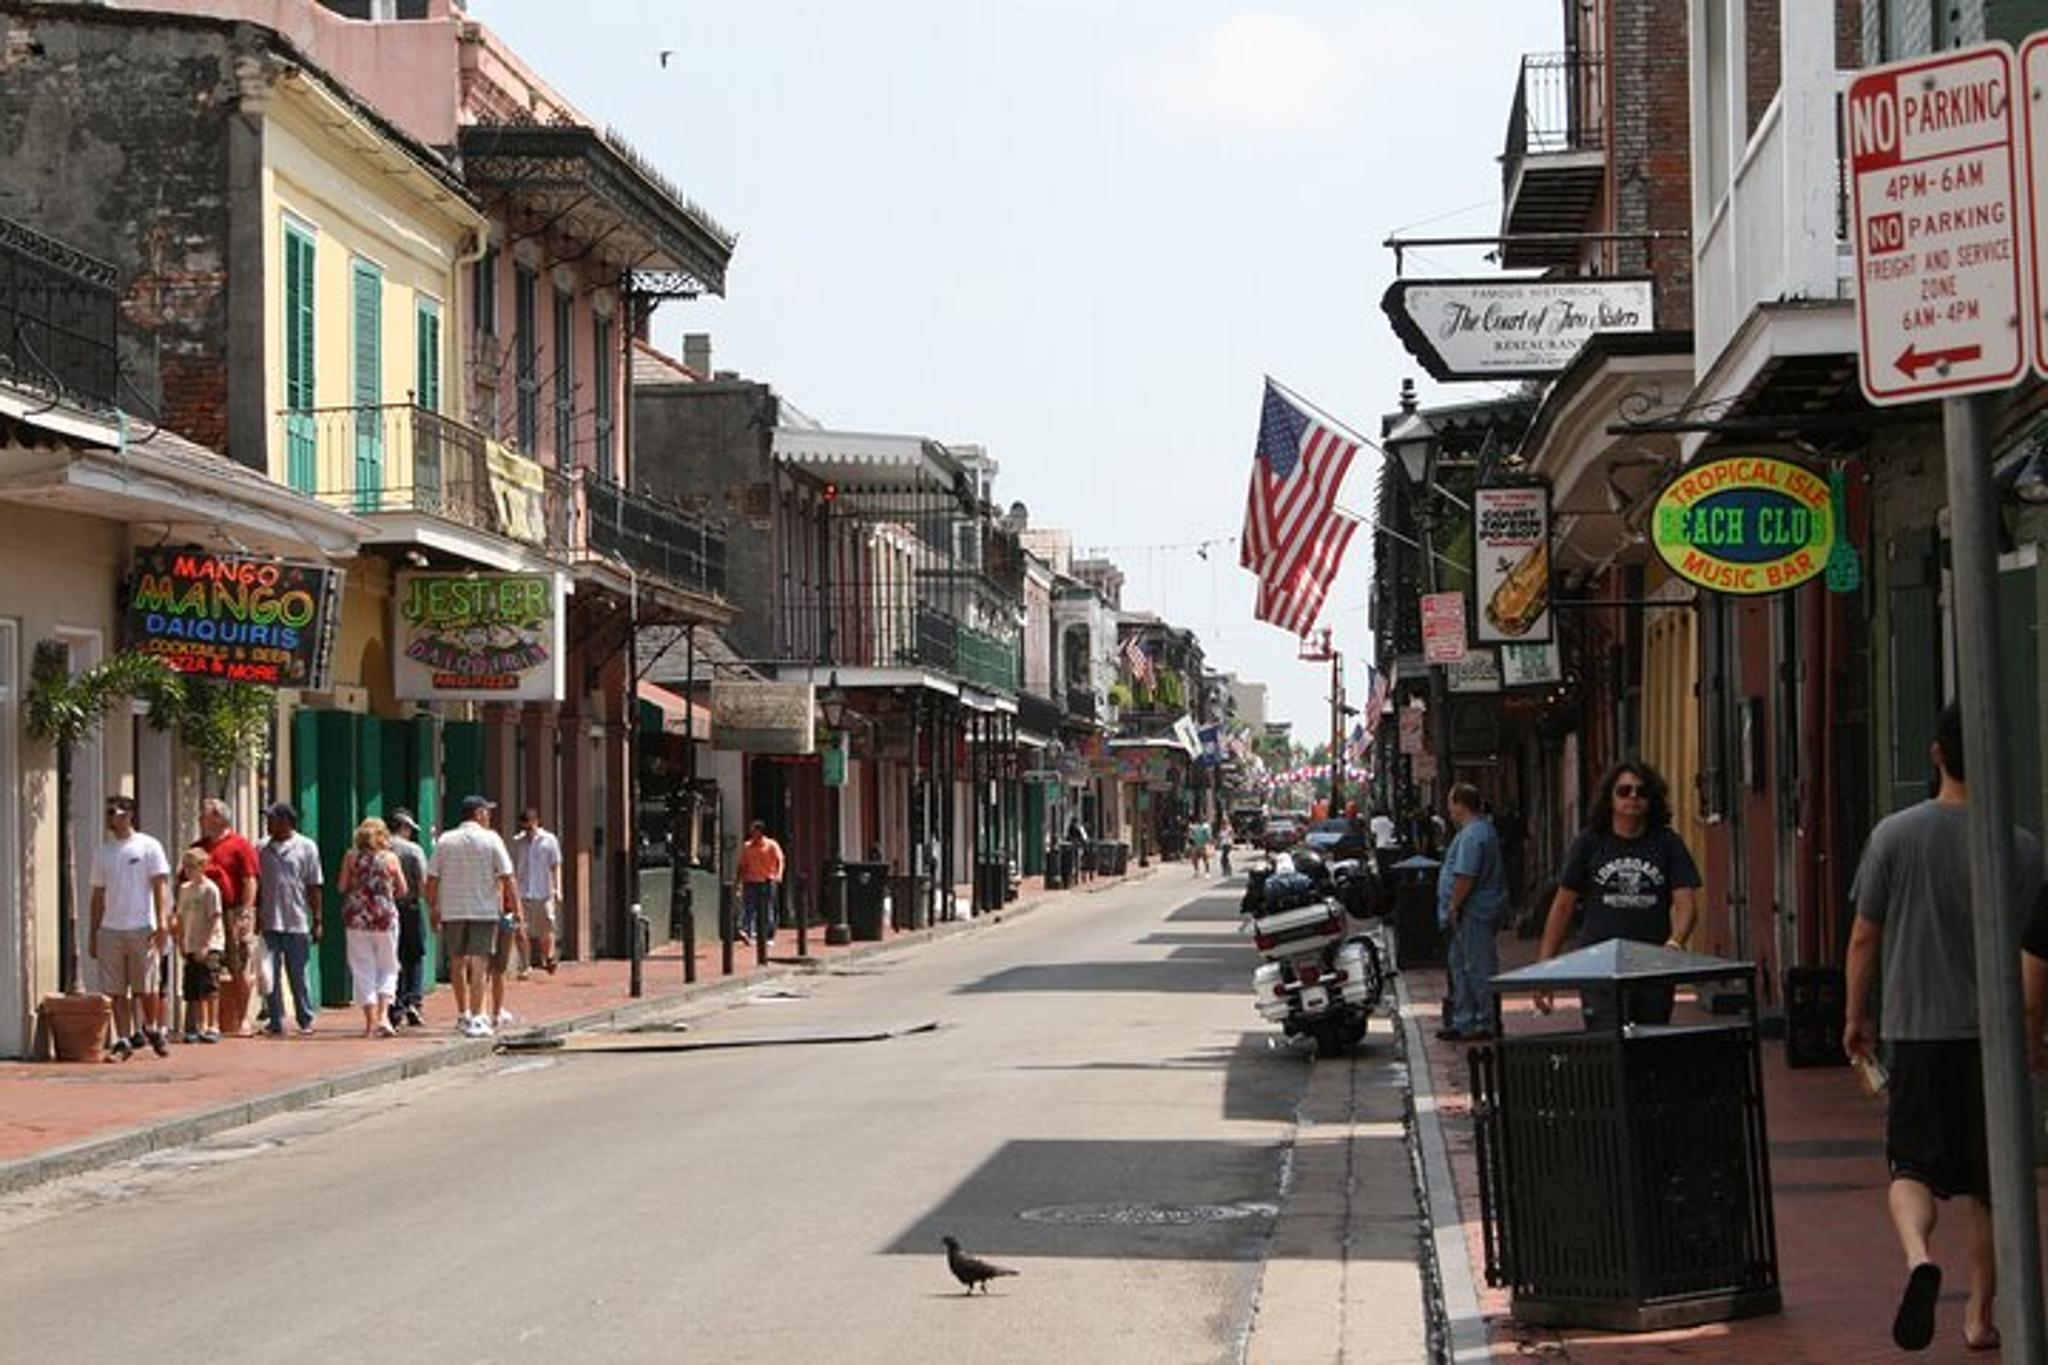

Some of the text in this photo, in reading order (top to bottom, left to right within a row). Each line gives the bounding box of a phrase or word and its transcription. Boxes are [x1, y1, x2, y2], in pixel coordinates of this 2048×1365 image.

[1852, 92, 1896, 157] NO
[1871, 202, 2005, 249] NO PARKING
[1867, 238, 2011, 280] FREIGHT AND SERVICE
[1921, 275, 1958, 300] ZONE
[1440, 299, 1639, 341] The Court of Two Sisters
[1668, 461, 1831, 509] TROPICAL ISLE
[1659, 506, 1826, 545] BEACH CLUB
[173, 555, 279, 587] MANGO
[1682, 551, 1813, 588] MUSIC BAR
[134, 573, 316, 628] MANGO
[405, 579, 546, 619] JESTER
[146, 613, 299, 649] DAIQUIRIS
[226, 663, 280, 682] MORE
